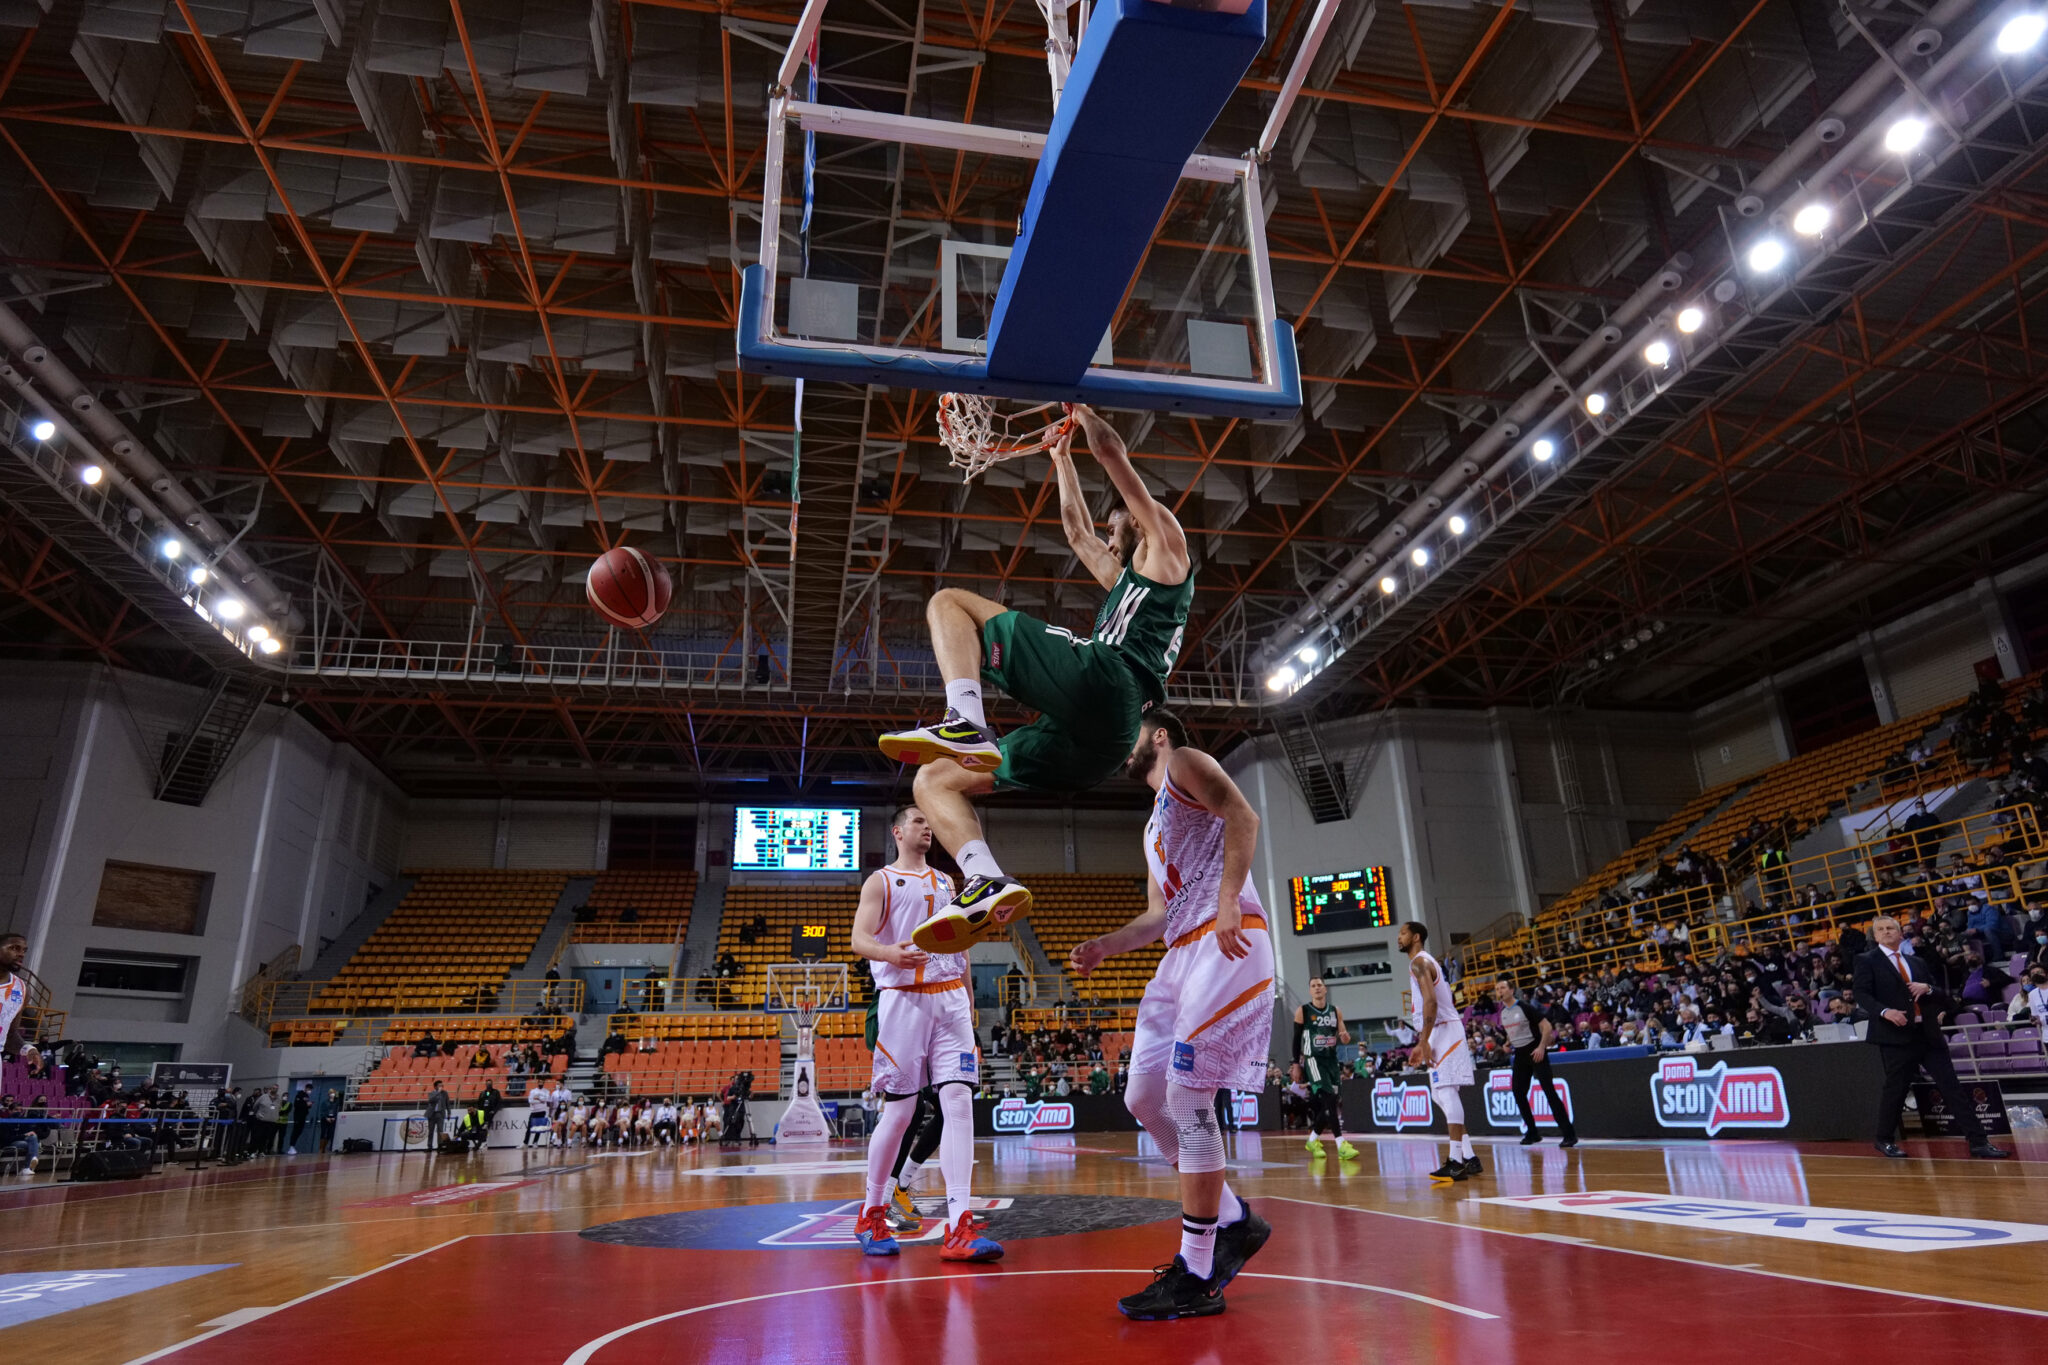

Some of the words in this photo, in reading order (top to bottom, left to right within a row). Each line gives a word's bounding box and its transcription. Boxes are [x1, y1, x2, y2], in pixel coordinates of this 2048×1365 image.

[1315, 894, 1328, 905] 62
[1353, 890, 1365, 900] 75
[801, 925, 826, 938] 3:00
[1665, 1066, 1690, 1081] pame
[1612, 1202, 2013, 1241] EKO
